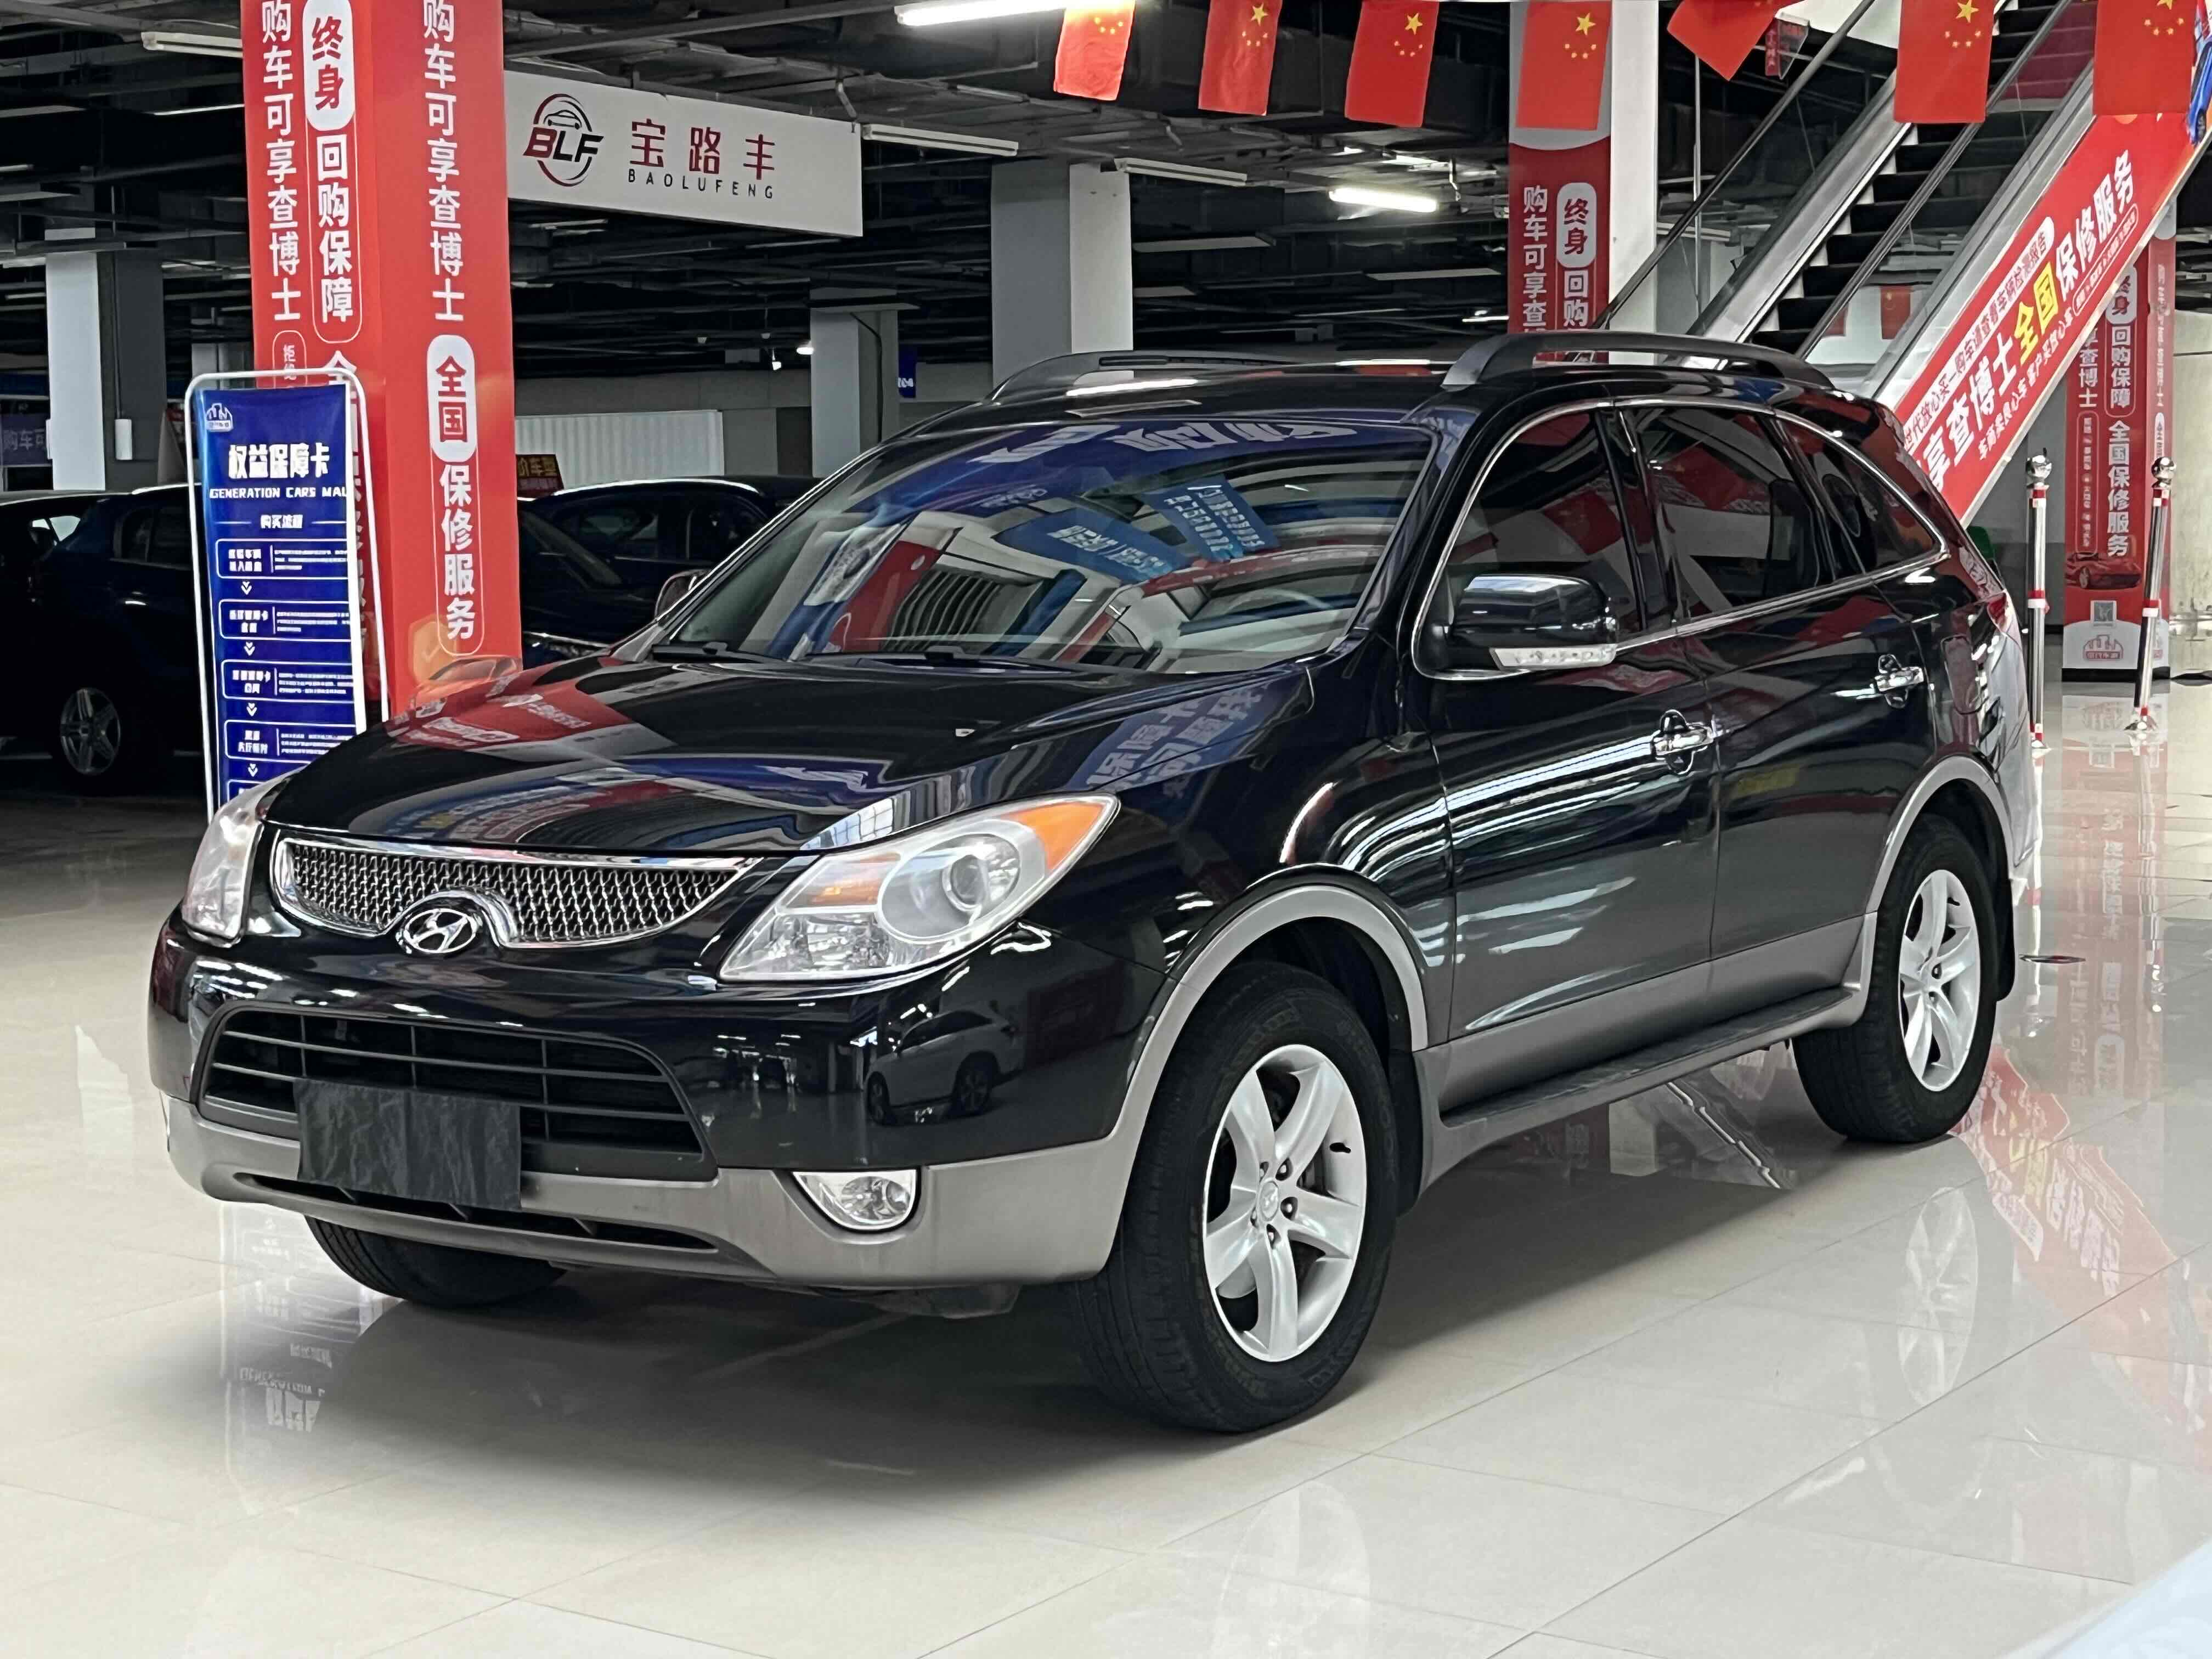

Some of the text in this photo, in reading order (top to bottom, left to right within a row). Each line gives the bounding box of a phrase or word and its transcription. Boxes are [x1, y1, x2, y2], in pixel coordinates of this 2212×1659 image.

[262, 0, 301, 321] 购车可享查博士
[422, 0, 465, 321] 购车可享查博士
[523, 126, 604, 163] BLF
[628, 168, 774, 199] BAOLUFENG
[629, 119, 776, 180] 宝路丰
[1522, 185, 1548, 333] 购车可享查
[1563, 198, 1589, 332] 终身回购
[209, 488, 280, 499] GENERATION
[286, 487, 316, 498] CARS
[228, 442, 330, 479] 权益保障卡
[2107, 420, 2131, 557] 全国保修服务
